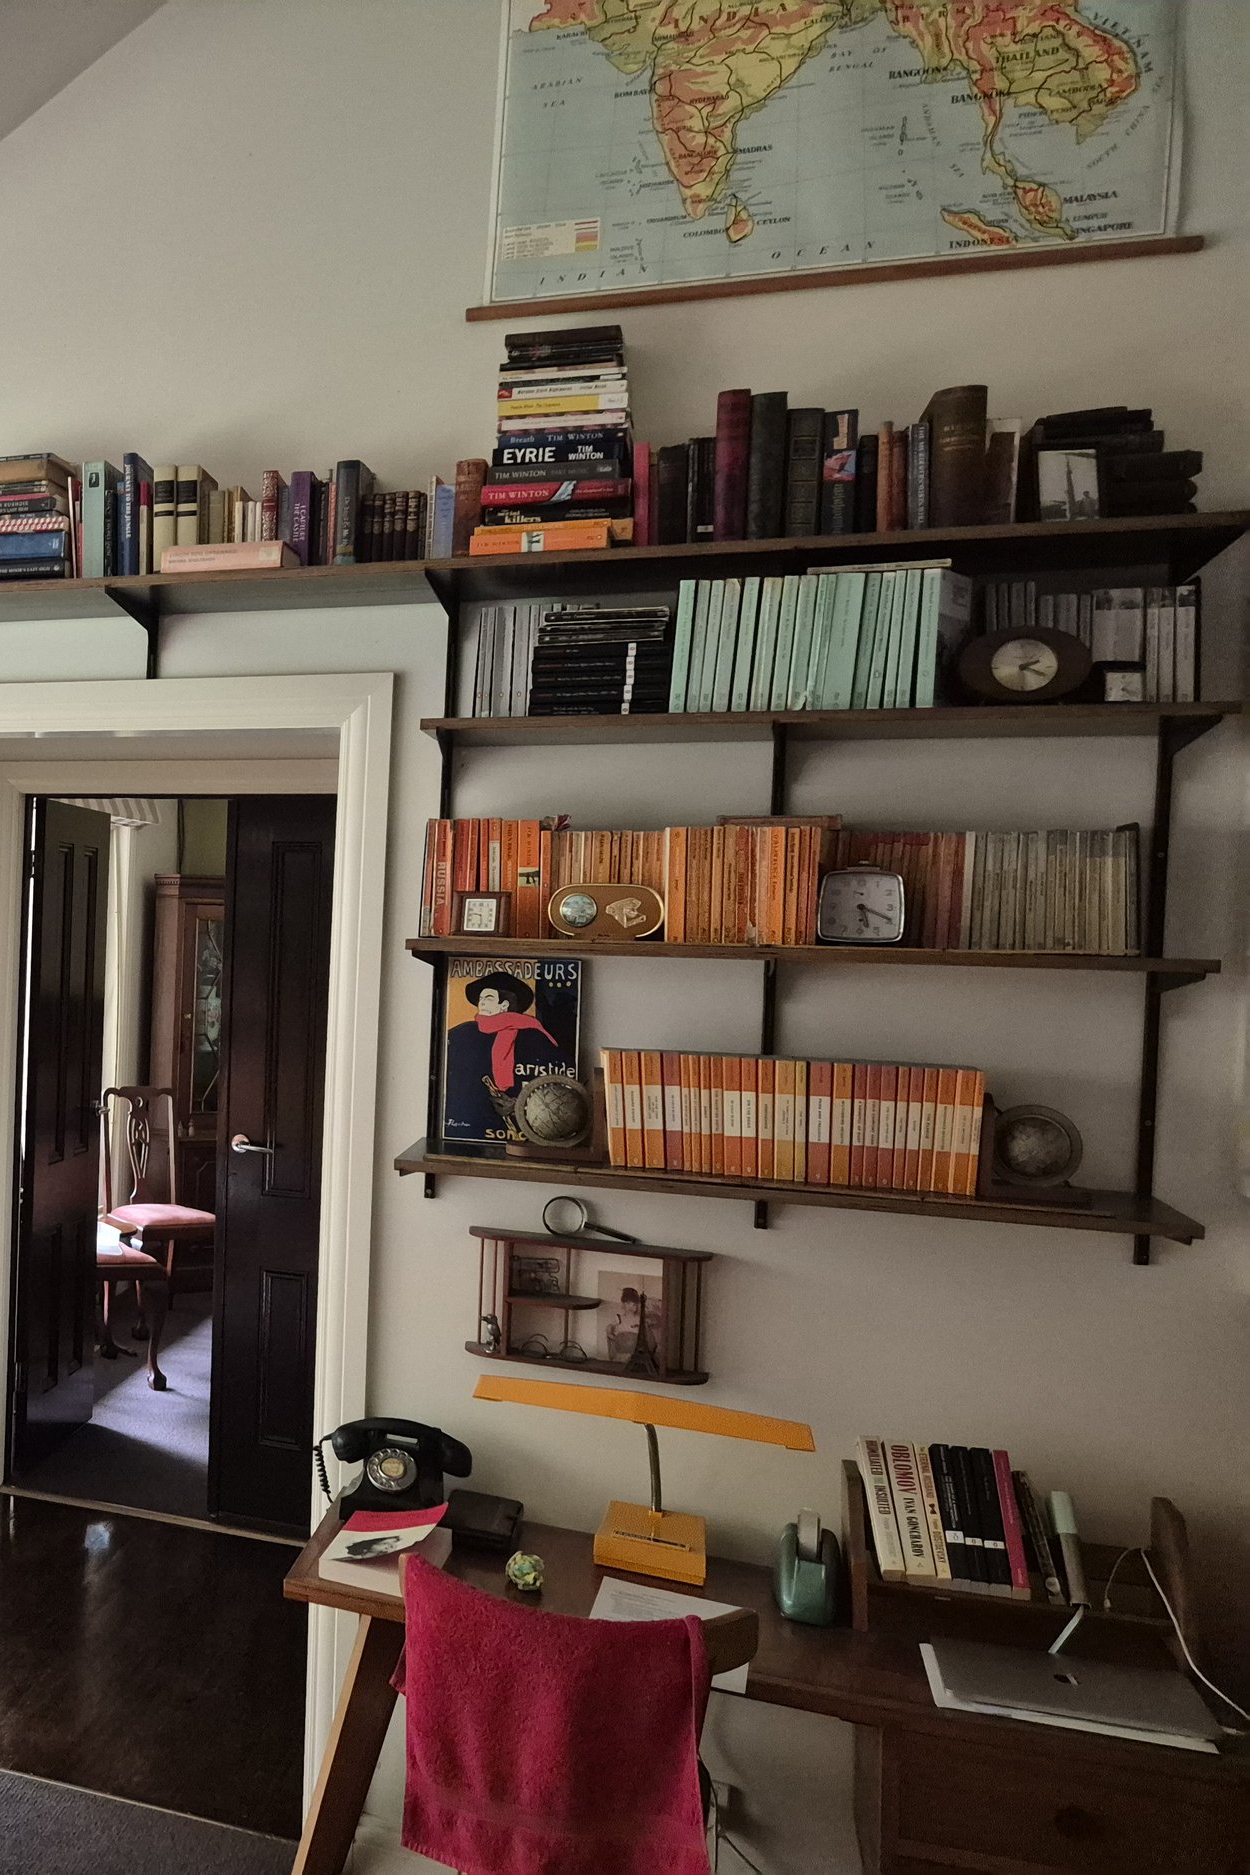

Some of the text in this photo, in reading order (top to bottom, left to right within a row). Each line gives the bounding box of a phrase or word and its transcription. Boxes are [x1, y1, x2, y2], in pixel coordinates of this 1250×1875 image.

[995, 46, 1060, 64] THAILAND
[888, 66, 943, 80] RANGOON
[532, 76, 584, 91] ARABIAN
[614, 88, 652, 99] BOMBAY
[950, 88, 1012, 104] BANGKOK
[543, 99, 566, 109] SEA
[739, 143, 773, 156] MADRAS
[1062, 190, 1118, 204] MALAYSIA
[757, 215, 792, 226] CEYLON
[682, 229, 727, 239] COLOMBO
[949, 236, 1018, 249] INDONESIA
[539, 264, 649, 287] INDIAN
[510, 432, 604, 444] Breath TIM WINTON
[502, 447, 557, 465] EYRIE
[577, 445, 594, 453] TIM
[568, 452, 604, 461] WINTON
[124, 464, 132, 491] JOURNEY
[495, 470, 547, 480] TIM WINTON
[125, 493, 132, 501] TO
[488, 489, 550, 500] TIM WINTON
[505, 514, 541, 524] killers
[124, 515, 132, 539] JUNGLE
[435, 862, 447, 905] RUSSIA
[451, 960, 578, 980] AMBASSADEURS
[514, 1062, 577, 1079] aristide
[873, 1484, 891, 1515] INSULTED
[890, 1445, 925, 1557] OBLOMOV IVAN GONCHAROV
